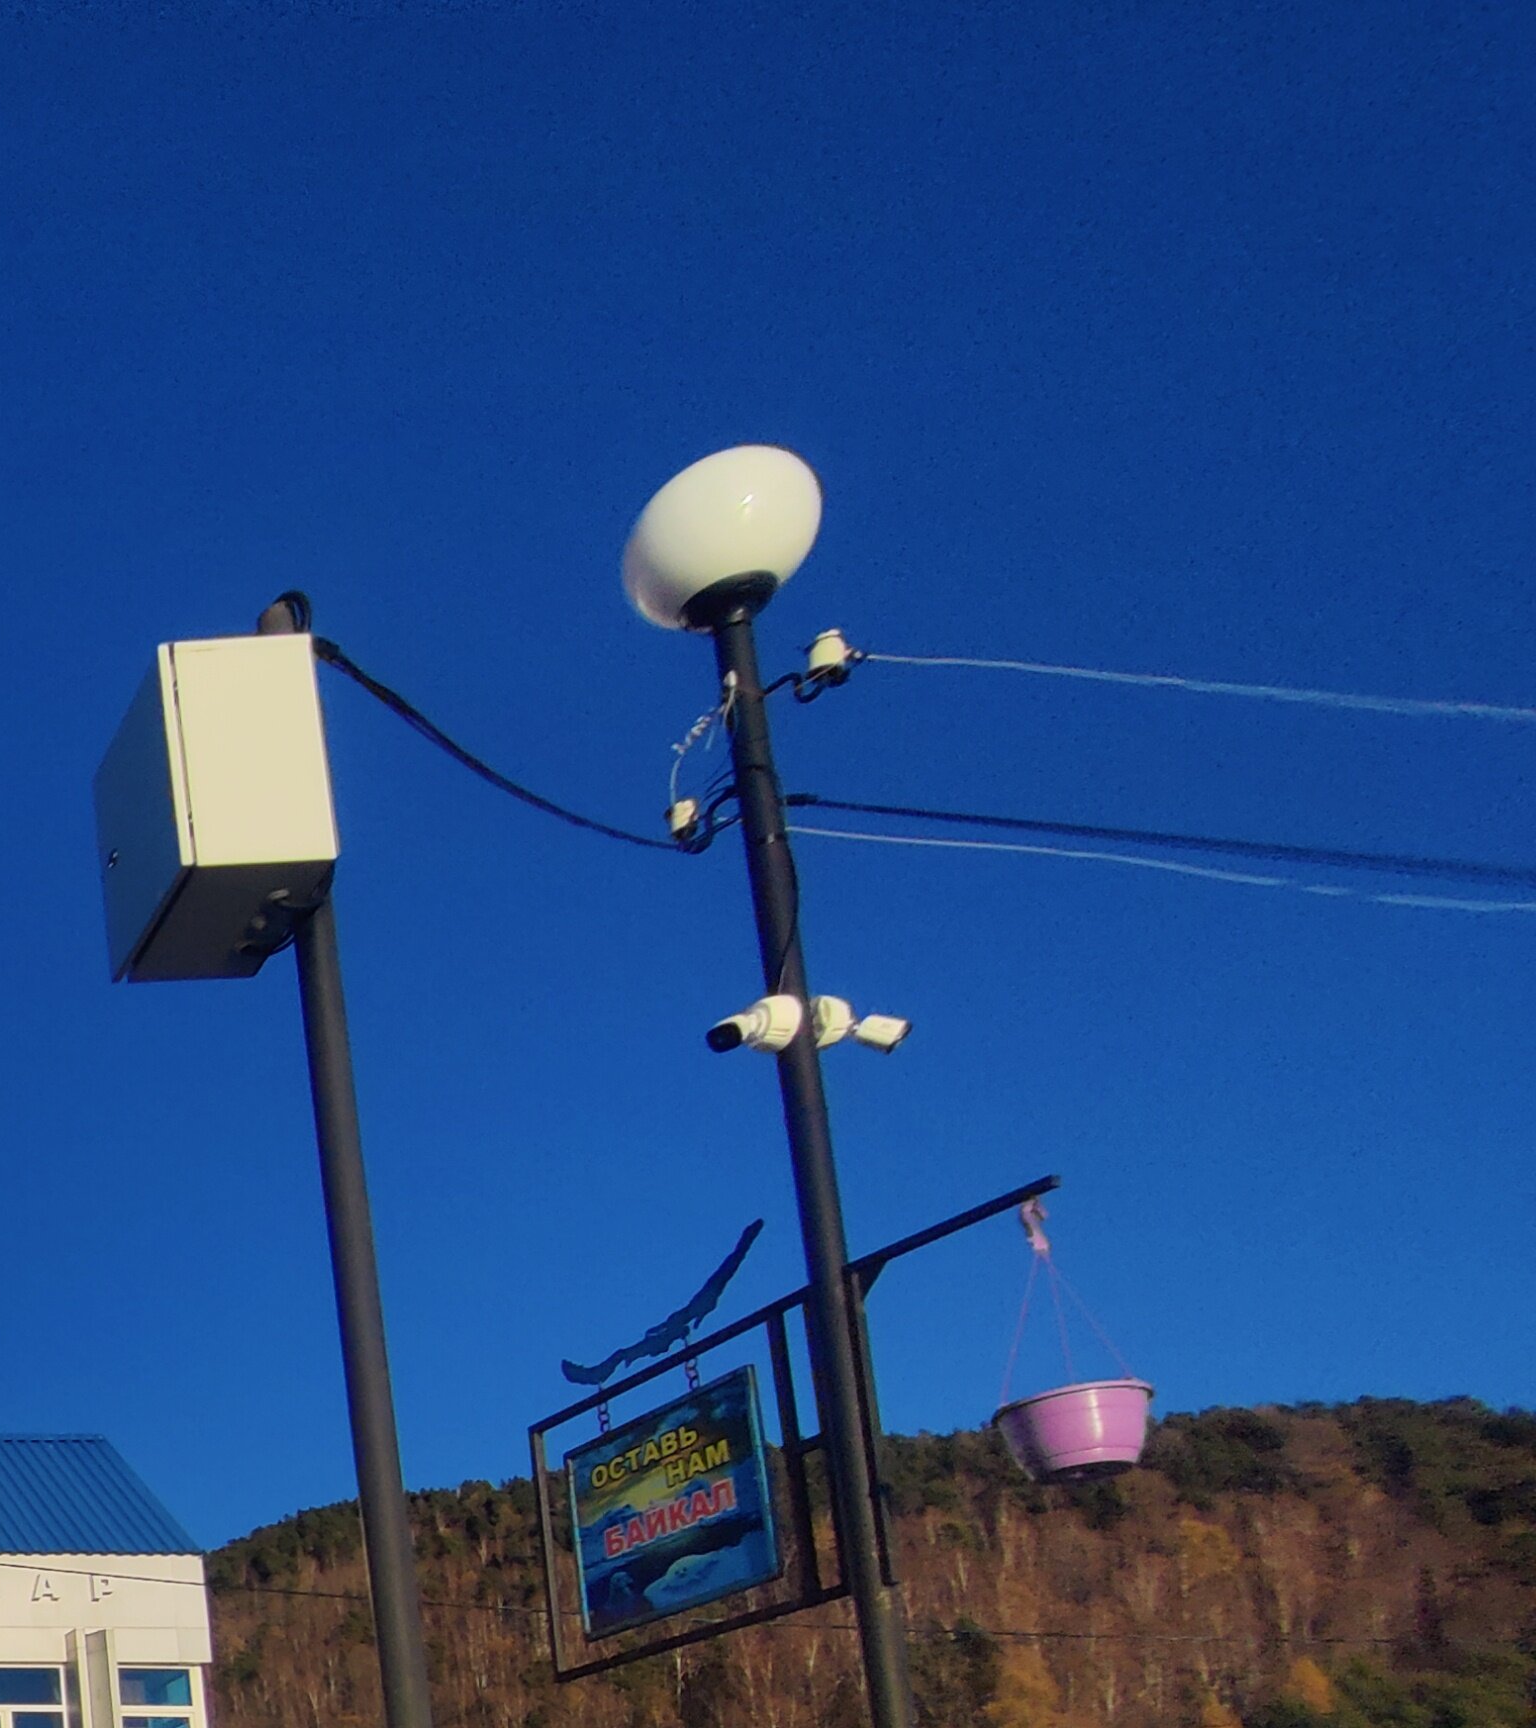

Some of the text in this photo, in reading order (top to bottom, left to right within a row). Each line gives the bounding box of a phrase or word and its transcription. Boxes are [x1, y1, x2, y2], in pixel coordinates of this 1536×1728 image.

[591, 1426, 698, 1489] ОСТАВЬ
[666, 1439, 730, 1488] НАМ
[603, 1477, 738, 1559] БАЙКАЛ
